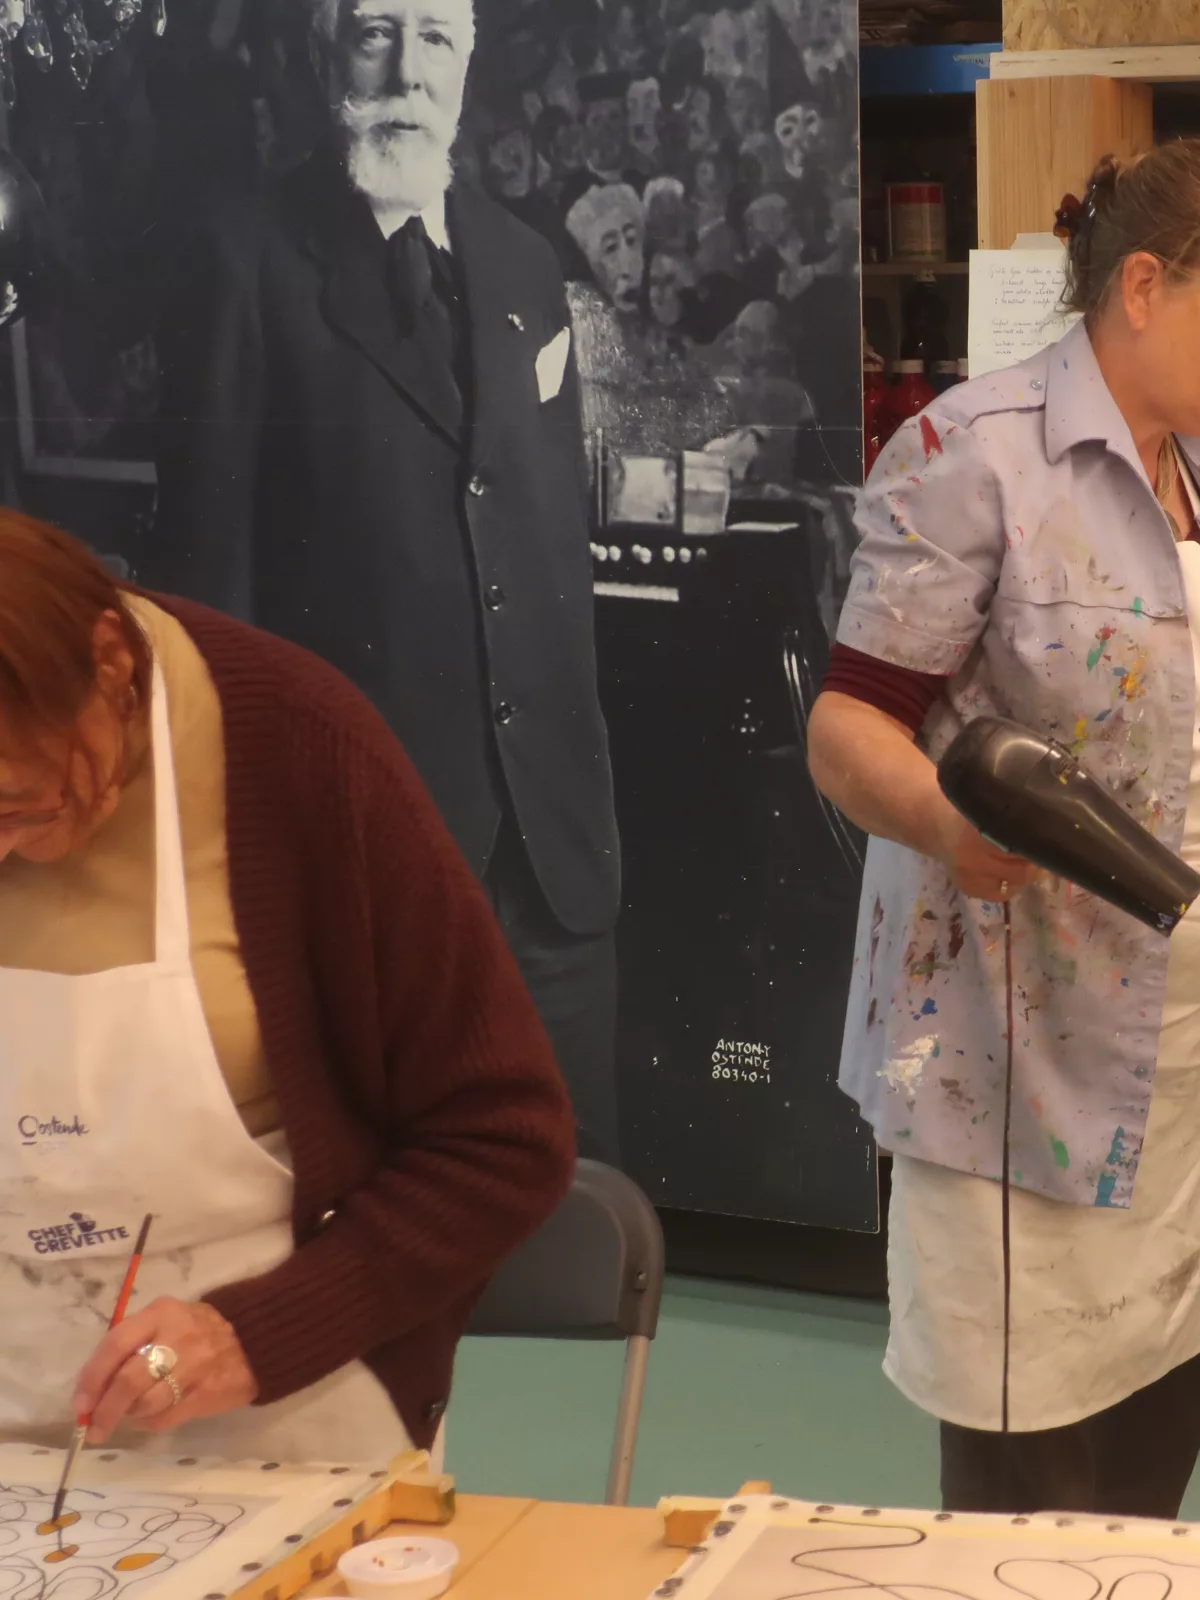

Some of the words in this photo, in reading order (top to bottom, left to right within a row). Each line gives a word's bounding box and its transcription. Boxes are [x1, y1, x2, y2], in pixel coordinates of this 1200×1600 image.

[715, 1038, 771, 1057] ANTONY
[27, 1223, 76, 1241] CHEF
[34, 1226, 130, 1254] CREVETTE
